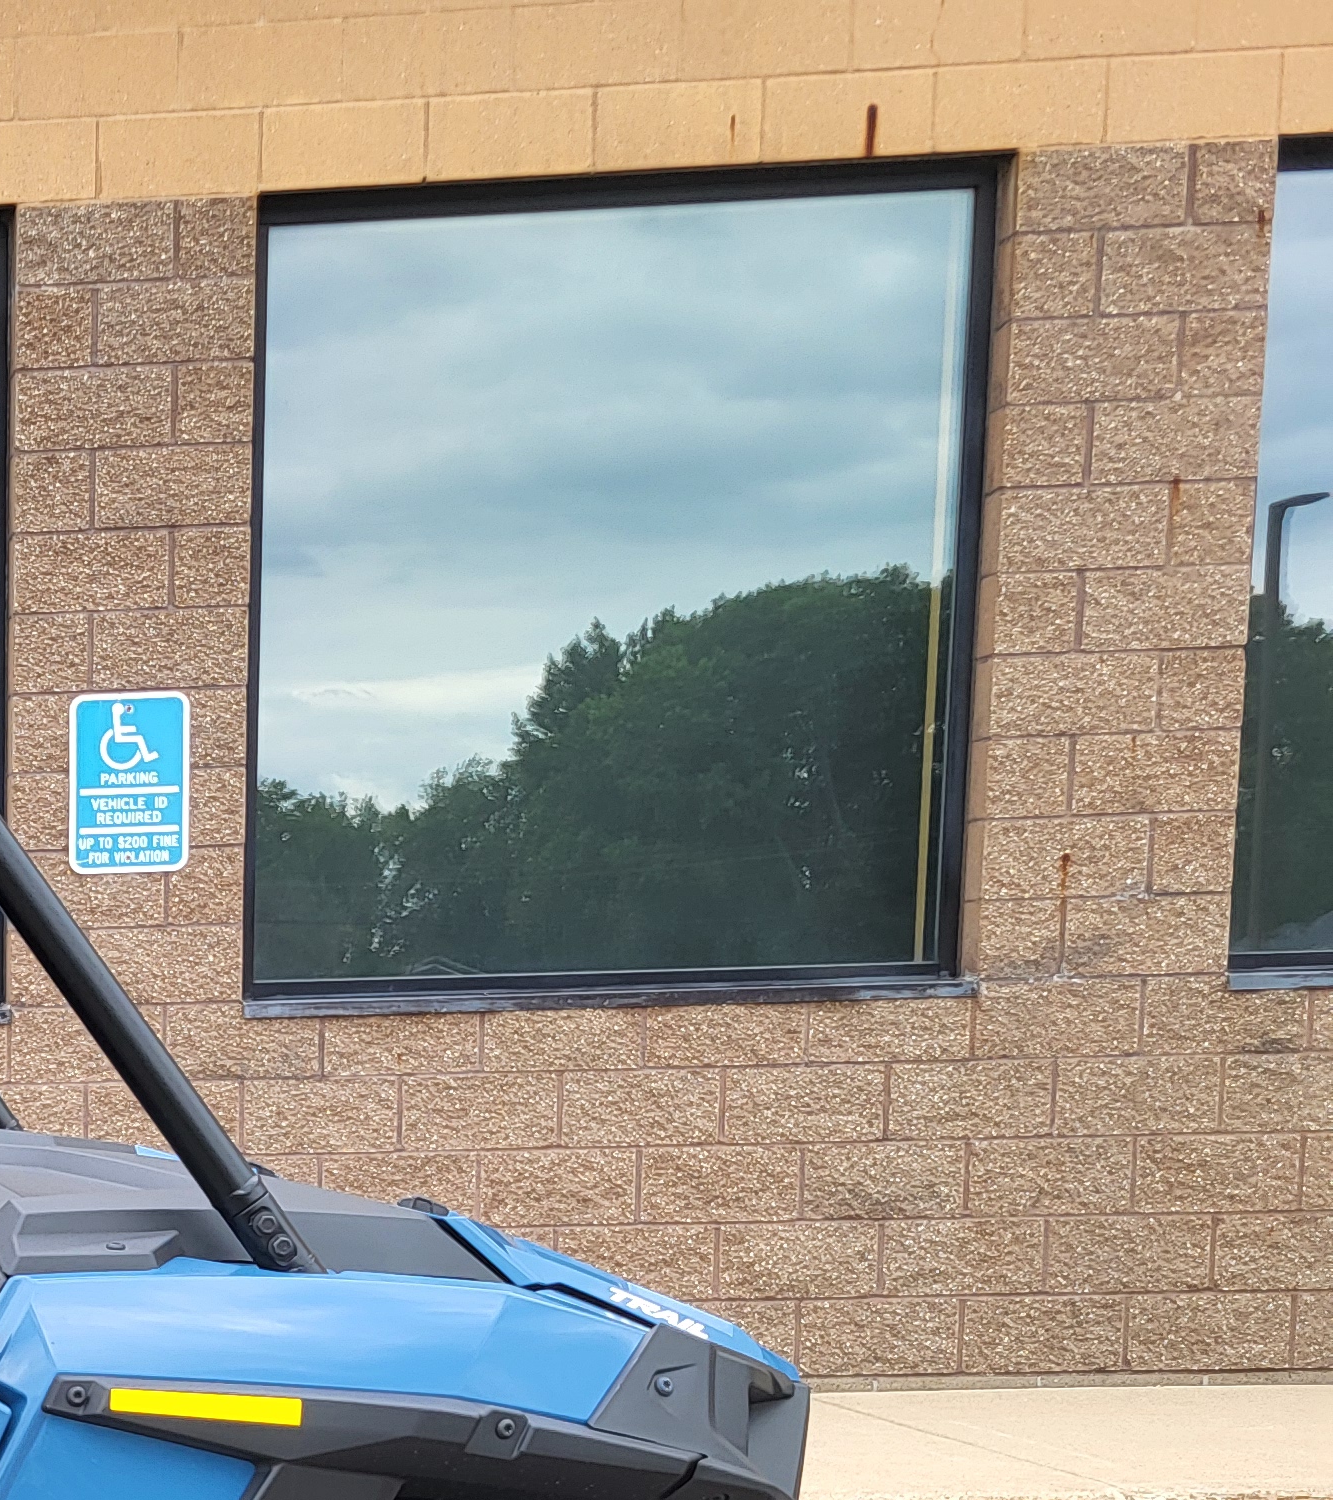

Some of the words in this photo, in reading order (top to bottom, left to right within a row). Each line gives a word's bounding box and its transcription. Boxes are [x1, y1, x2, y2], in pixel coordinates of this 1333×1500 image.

[100, 771, 159, 785] PARKING
[91, 797, 147, 811] VEHICLE
[154, 796, 168, 809] ID
[96, 811, 162, 825] REQUIRED
[78, 837, 95, 849] UP
[99, 837, 113, 849] TO
[117, 836, 148, 848] $200
[153, 835, 179, 847] FINE
[88, 852, 110, 865] FOR
[114, 850, 170, 864] VIOLATION
[609, 1286, 709, 1340] TRAIL
